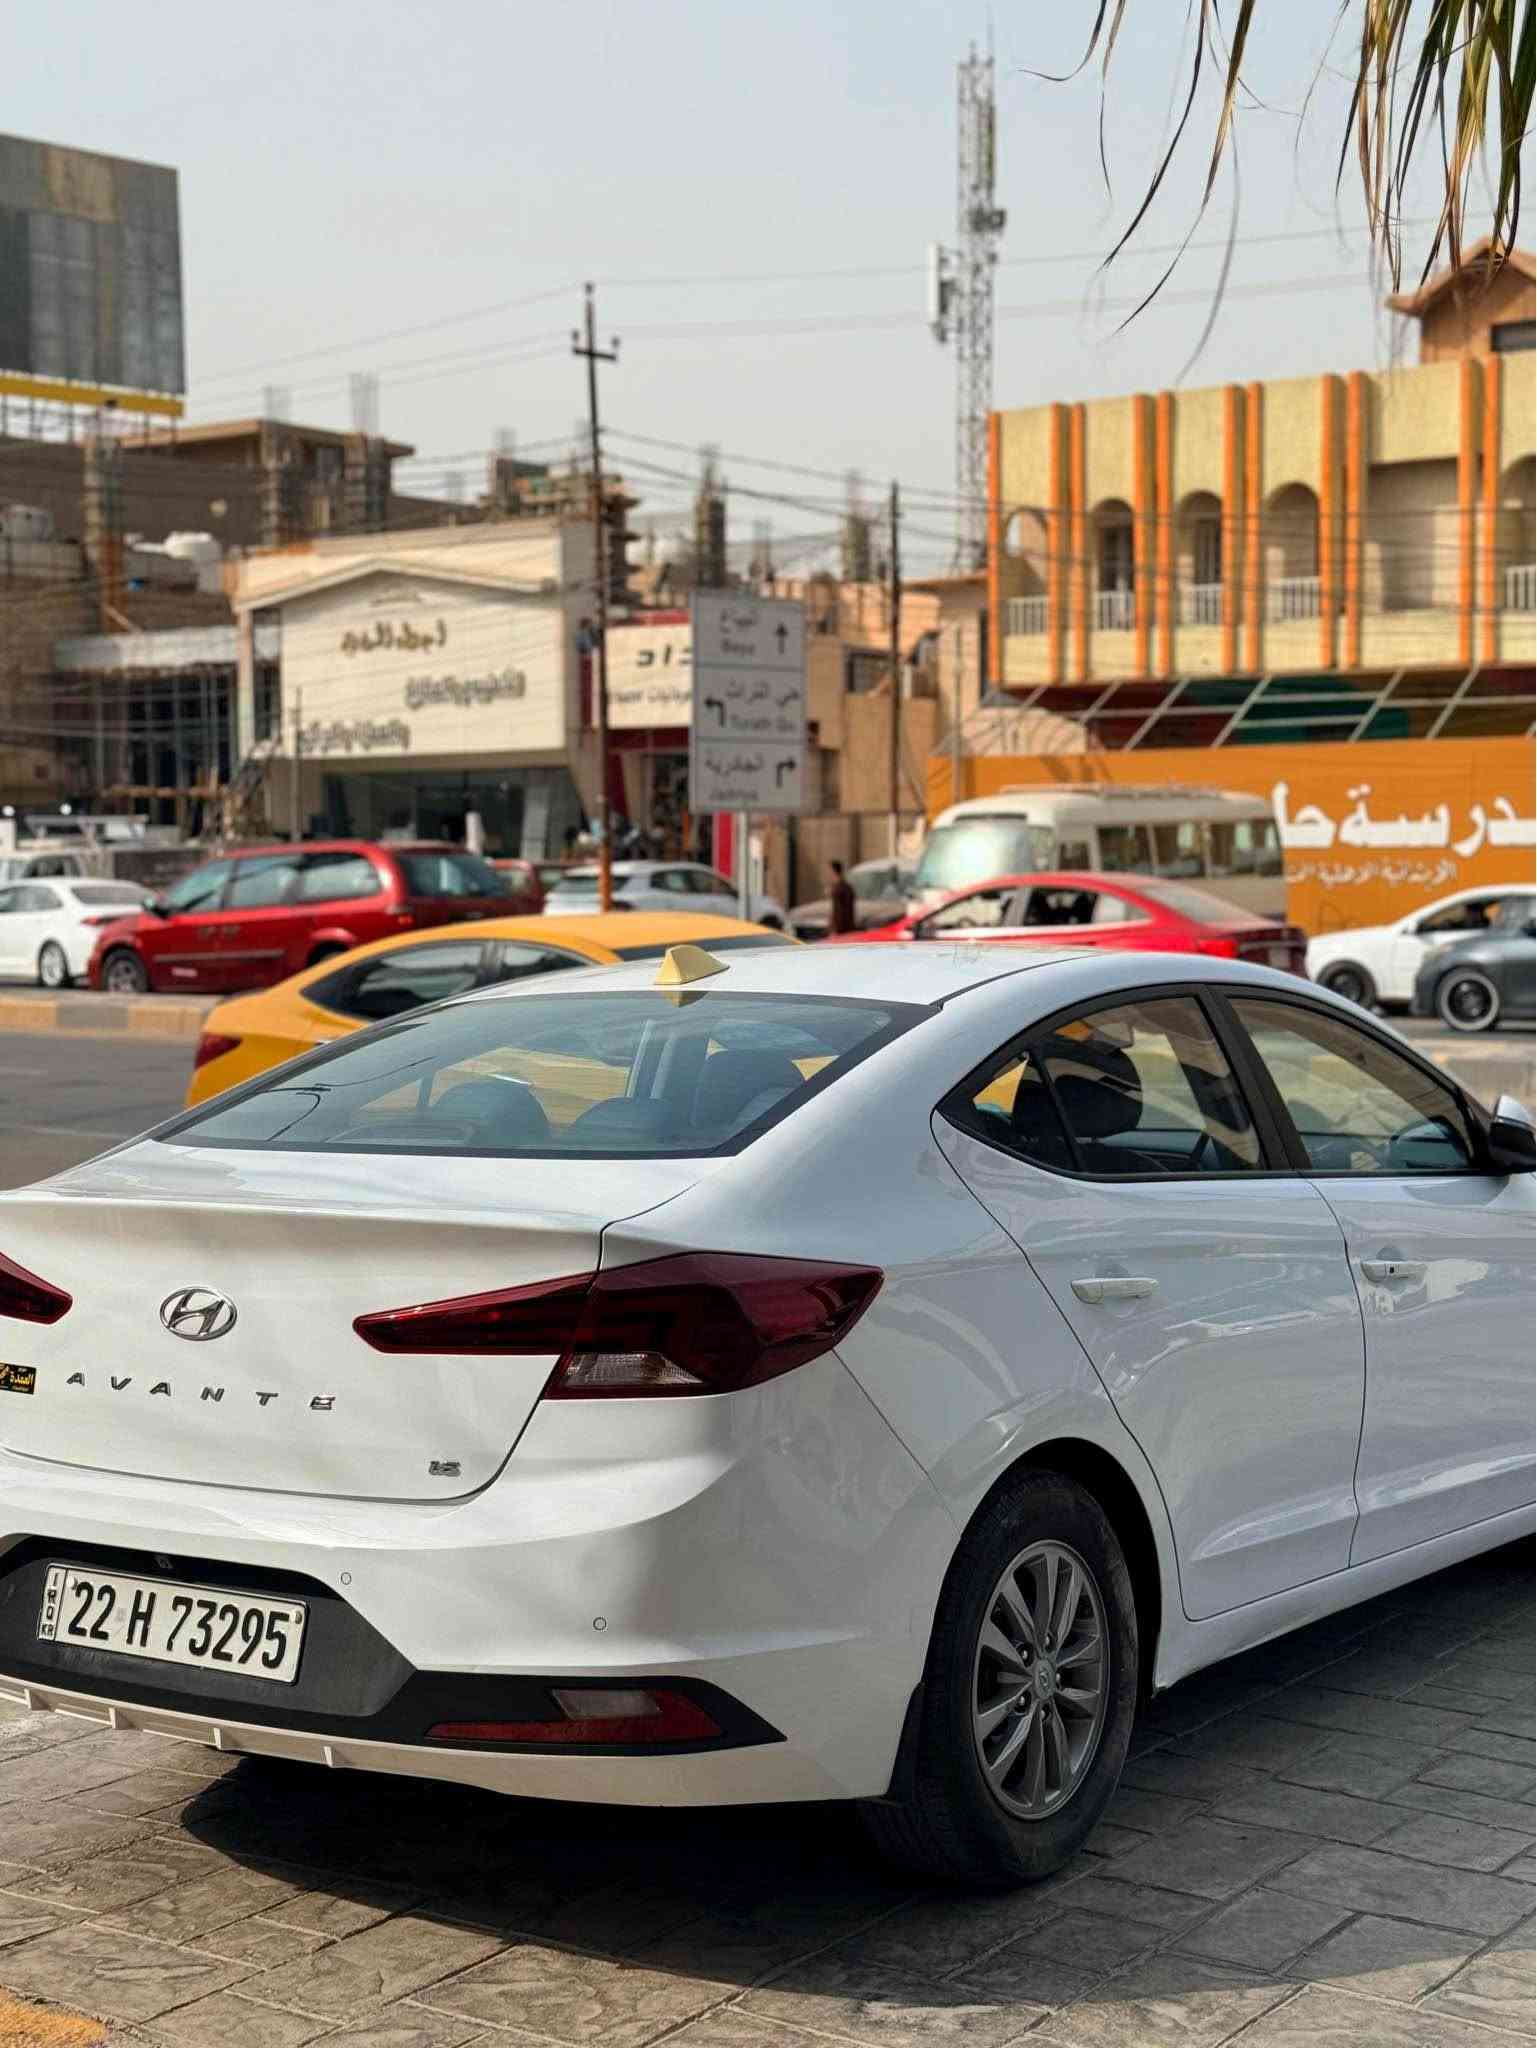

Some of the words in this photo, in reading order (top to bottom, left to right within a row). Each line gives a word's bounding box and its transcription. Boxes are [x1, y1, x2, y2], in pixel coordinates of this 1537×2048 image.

[1272, 780, 1336, 848] حا
[1339, 783, 1536, 857] درسة
[66, 1371, 336, 1411] AVANTE
[67, 1581, 117, 1640] 22
[126, 1589, 156, 1648] H
[166, 1595, 291, 1669] 73295
